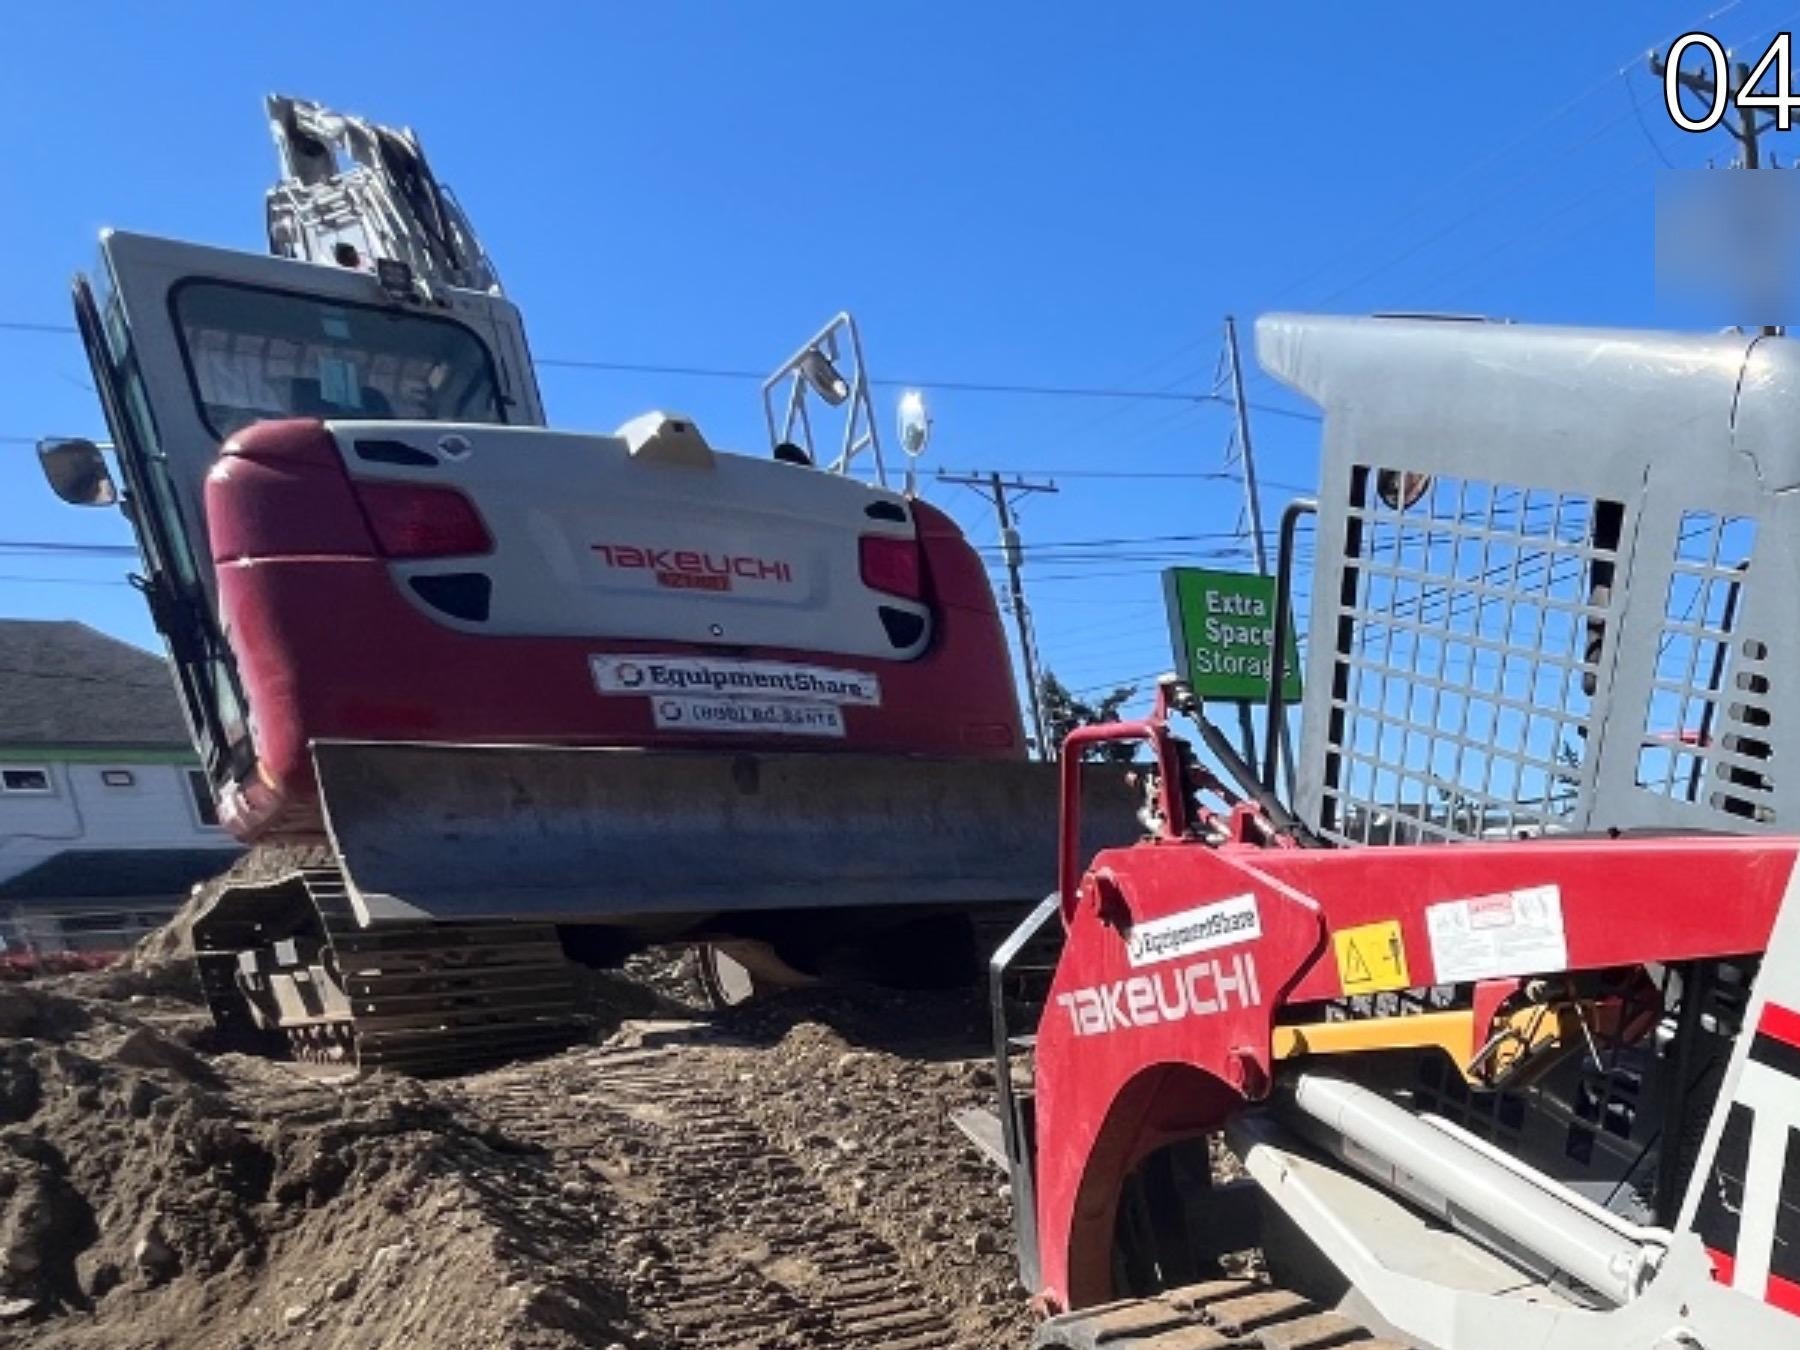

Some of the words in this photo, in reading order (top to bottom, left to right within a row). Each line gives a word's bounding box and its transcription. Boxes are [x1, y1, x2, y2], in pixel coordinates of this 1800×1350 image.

[1205, 590, 1266, 616] Extra
[648, 664, 863, 697] EquipmentShare
[1142, 911, 1255, 954] EquipmentShare
